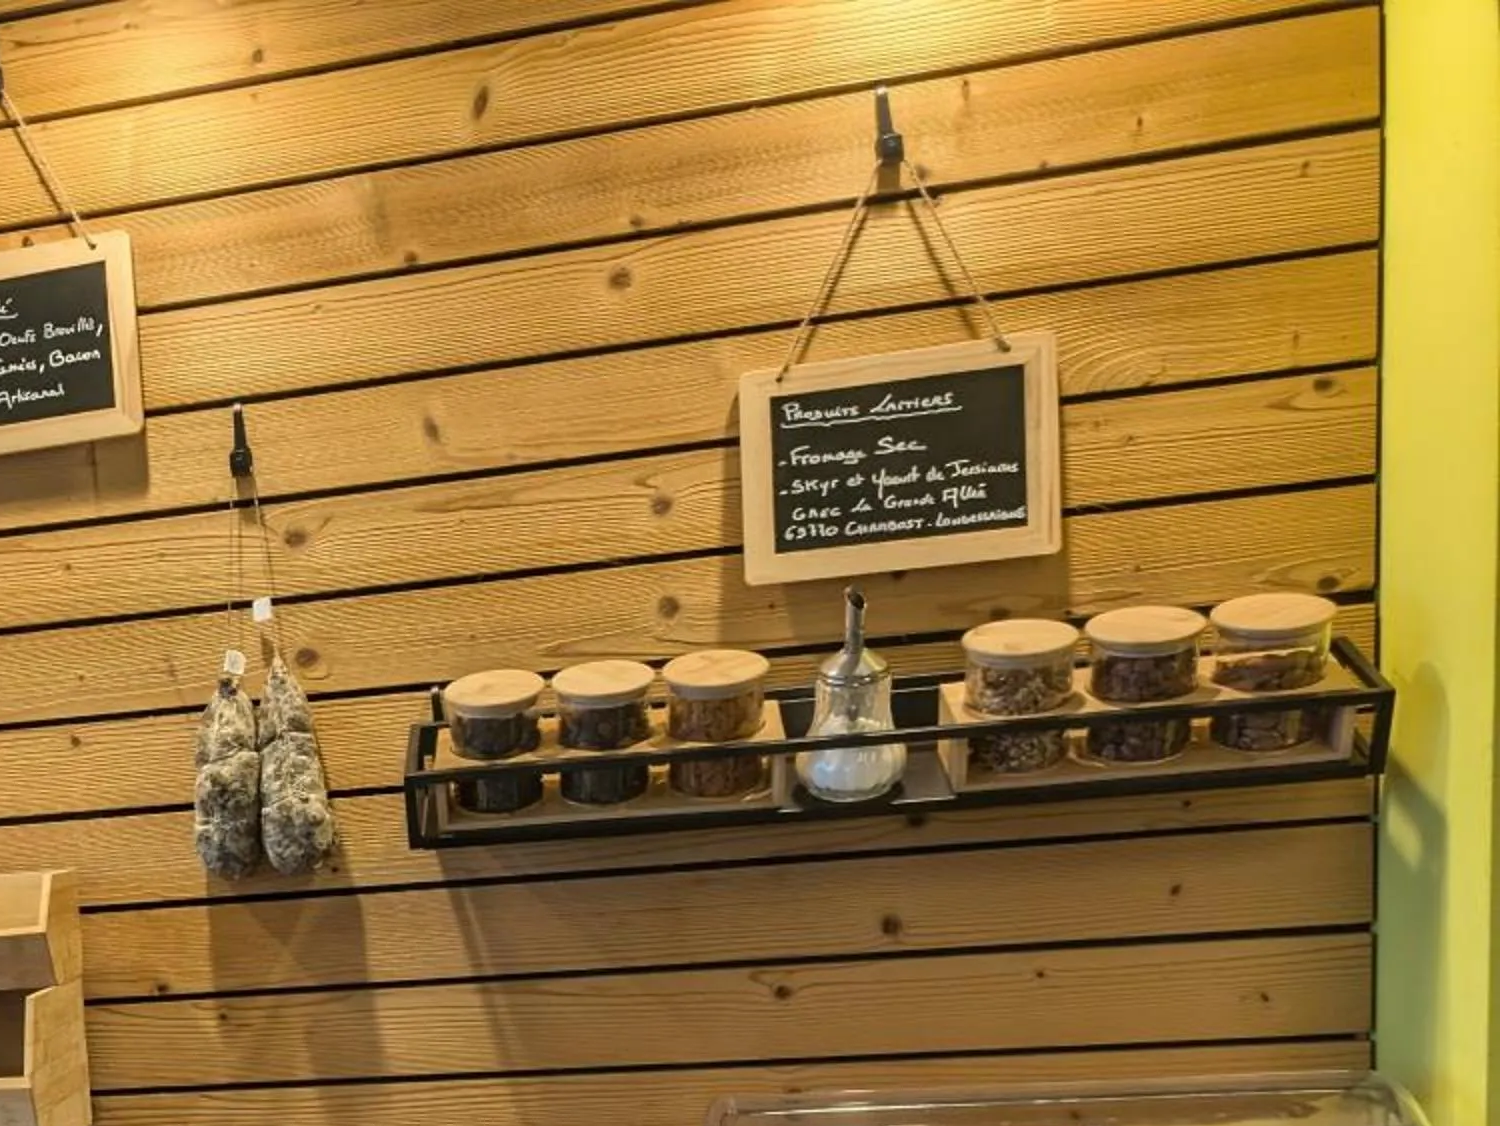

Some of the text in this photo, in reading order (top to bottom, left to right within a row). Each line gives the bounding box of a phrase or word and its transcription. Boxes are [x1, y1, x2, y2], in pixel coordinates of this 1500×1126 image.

[49, 349, 101, 367] Bacon
[873, 435, 928, 455] Sec
[846, 473, 865, 487] et
[925, 465, 945, 482] de
[850, 497, 874, 513] La
